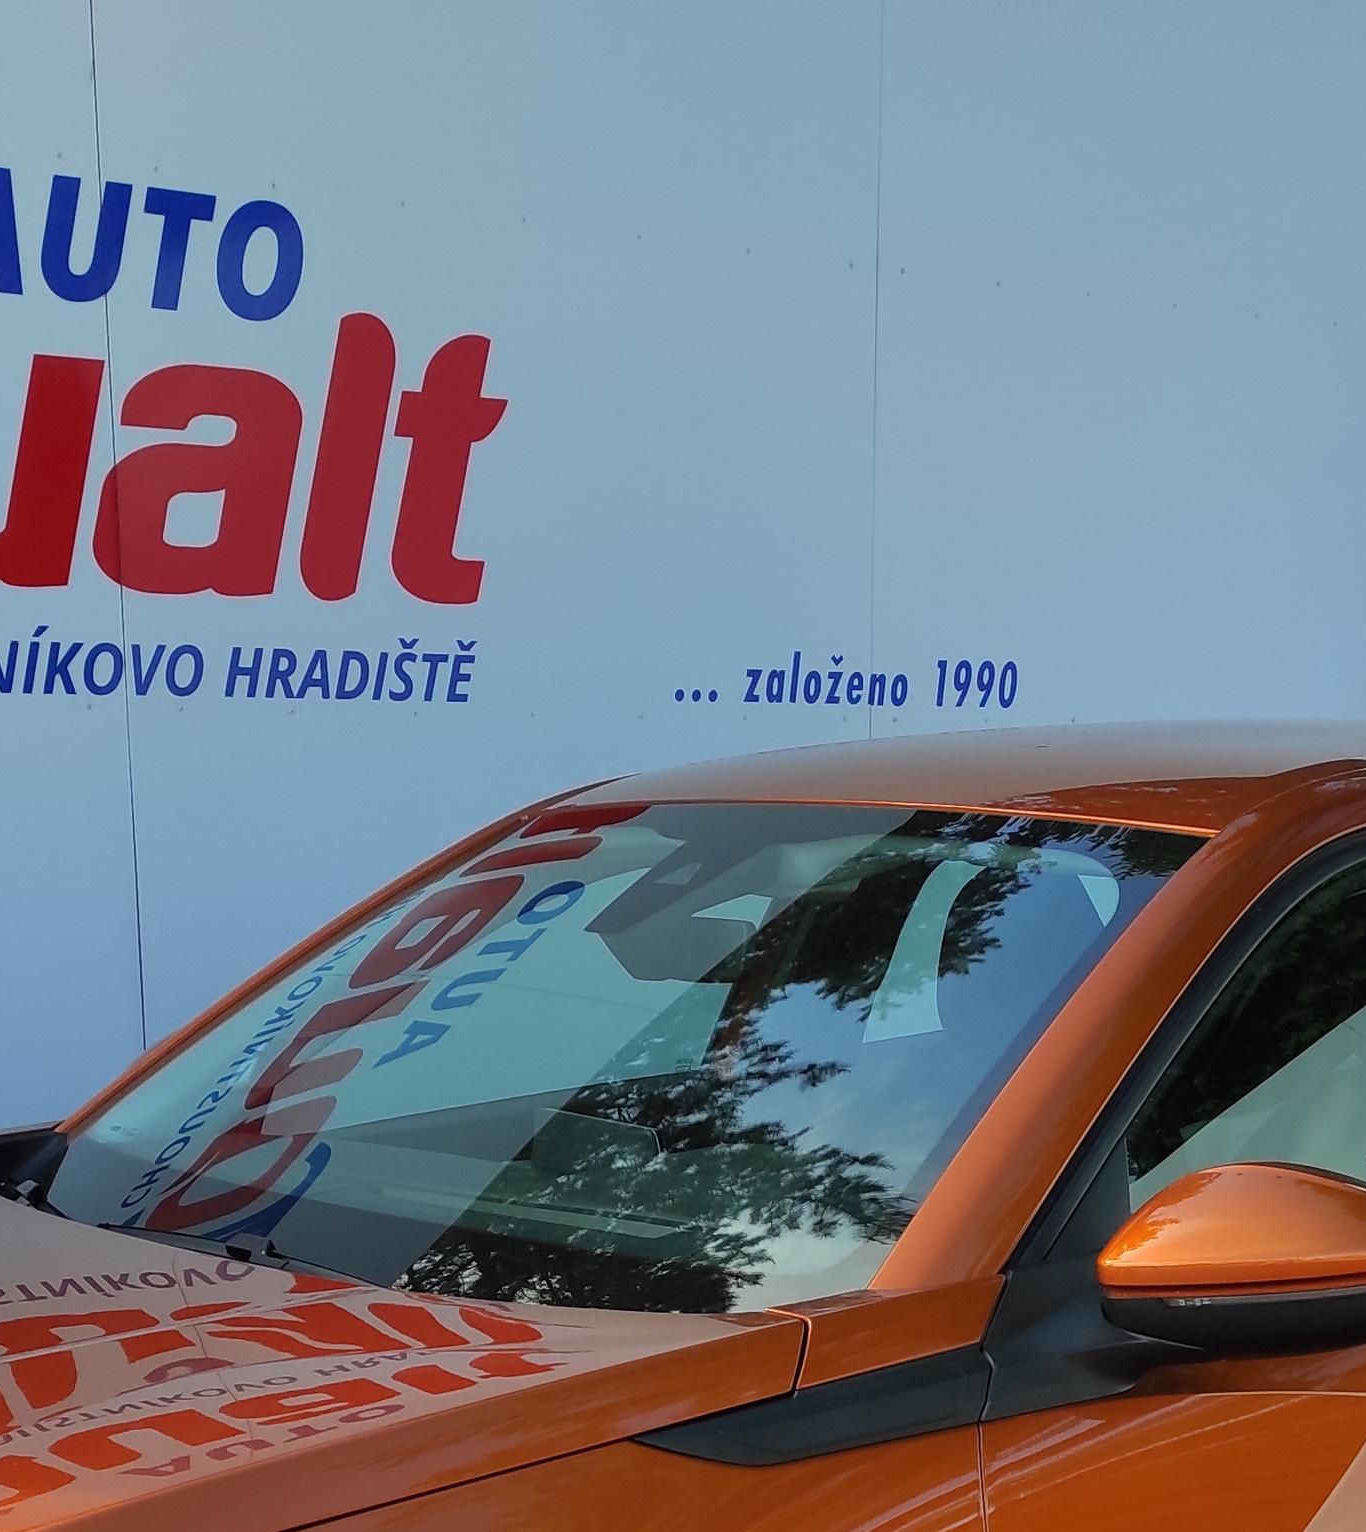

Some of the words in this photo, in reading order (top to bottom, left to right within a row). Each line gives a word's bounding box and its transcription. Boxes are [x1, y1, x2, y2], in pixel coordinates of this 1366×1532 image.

[225, 638, 478, 703] HRADIŠTĚ
[742, 651, 909, 708] založeno
[935, 659, 1018, 709] 1990
